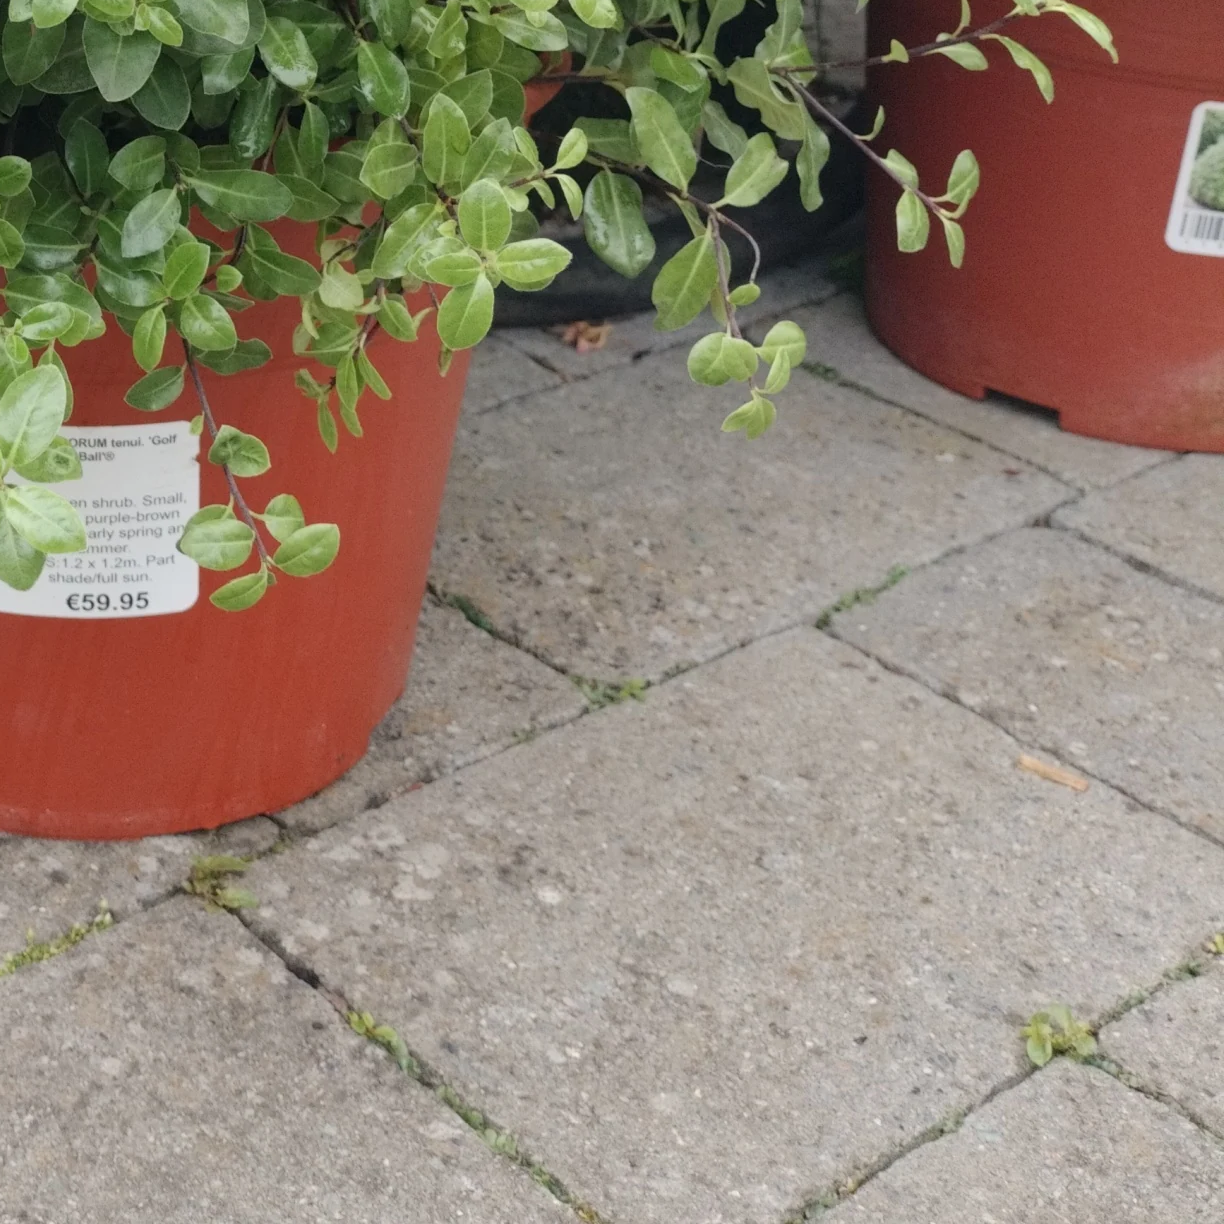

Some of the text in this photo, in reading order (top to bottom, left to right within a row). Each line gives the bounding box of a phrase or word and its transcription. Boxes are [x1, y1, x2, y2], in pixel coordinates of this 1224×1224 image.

[69, 433, 177, 448] ORUM tenui. 'Golf
[92, 496, 136, 508] shrub.
[142, 492, 187, 507] Small,
[85, 510, 180, 526] purple-brown
[87, 524, 185, 540] arly spring an
[88, 560, 96, 569] x
[103, 556, 140, 569] 1.2m.
[146, 554, 175, 567] Part
[48, 571, 152, 585] shade/full sun.
[66, 591, 150, 611] €59.95
